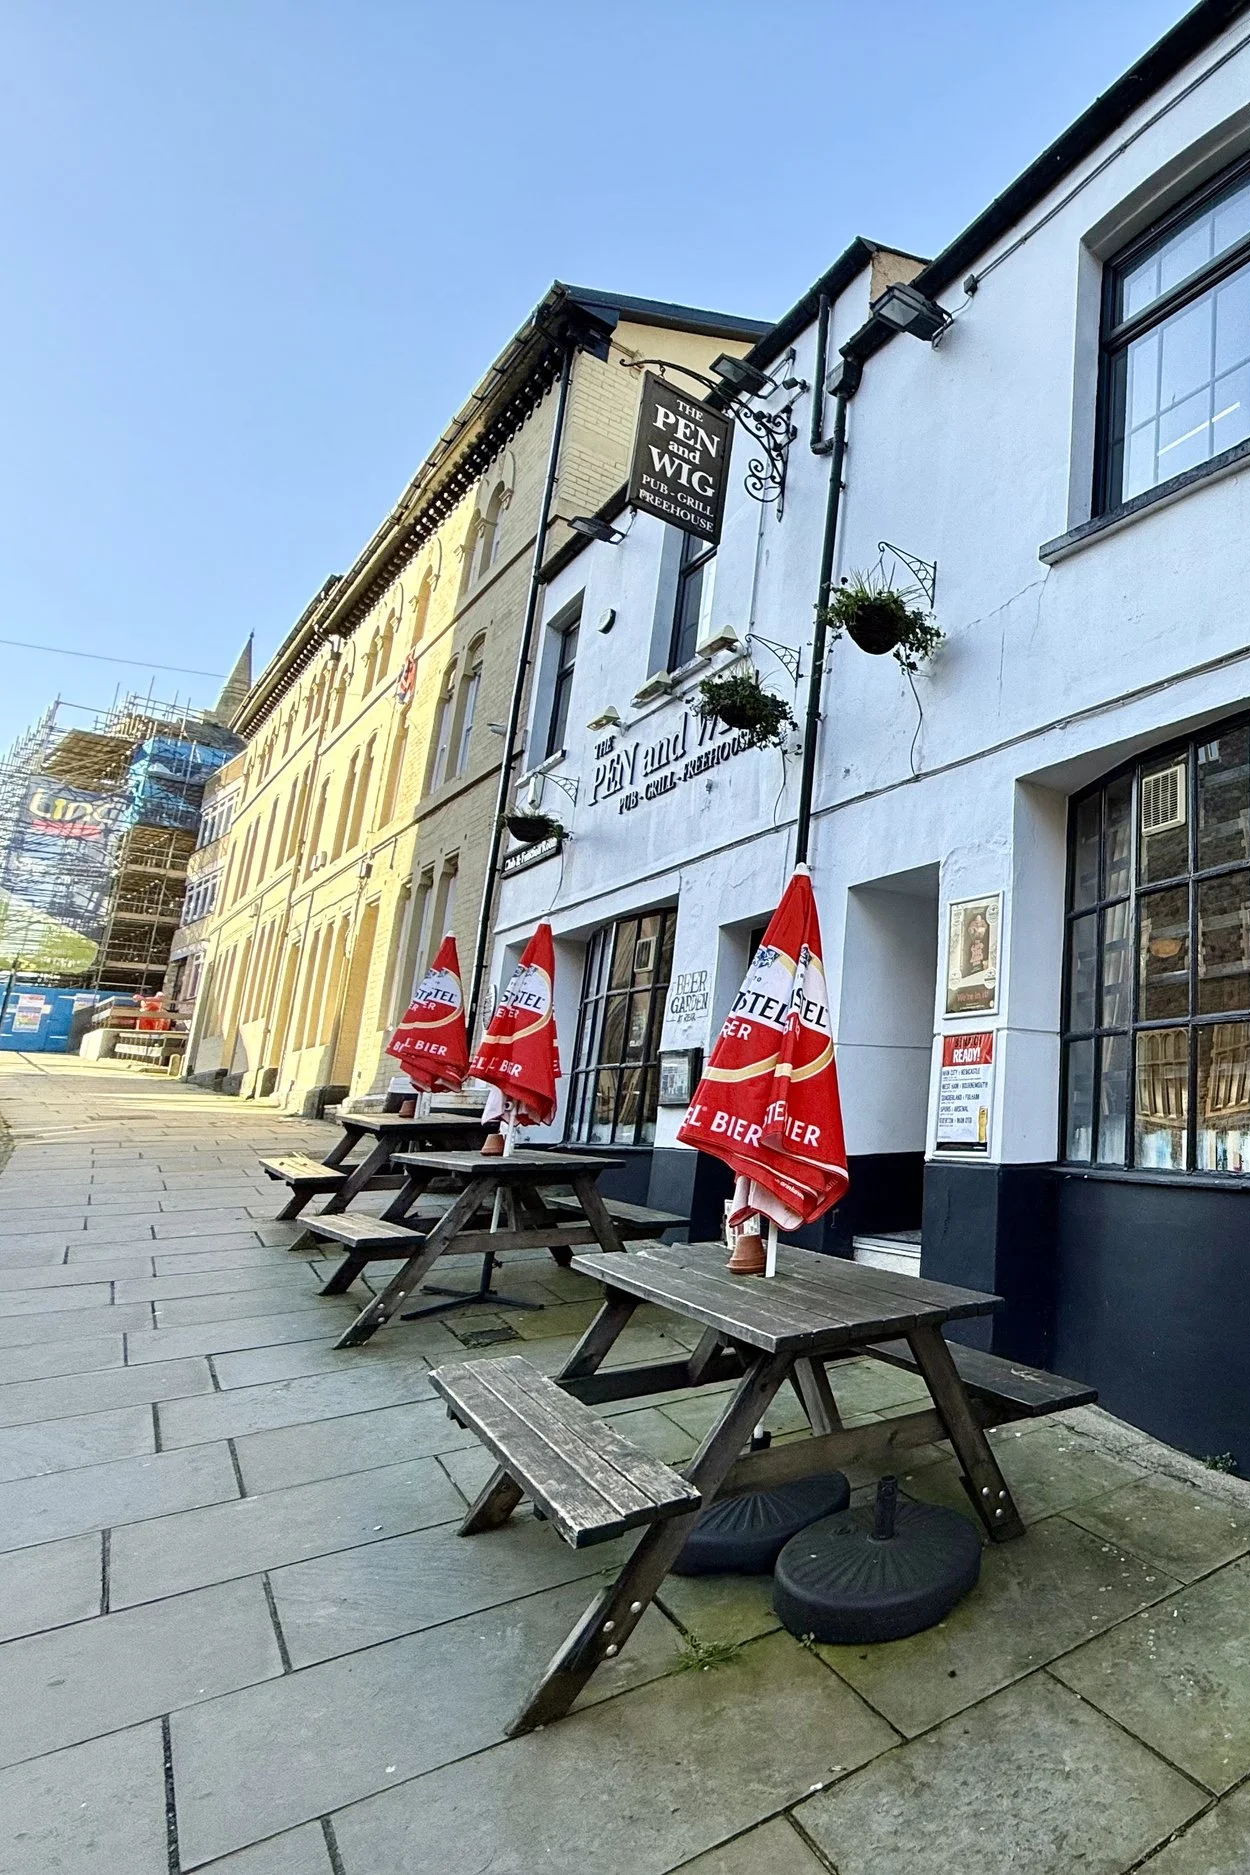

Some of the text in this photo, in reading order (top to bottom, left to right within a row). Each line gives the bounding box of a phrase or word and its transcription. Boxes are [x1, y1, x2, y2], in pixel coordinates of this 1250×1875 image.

[677, 399, 703, 422] THE
[652, 403, 720, 458] PEN
[668, 440, 700, 465] and
[648, 444, 715, 497] WIG
[642, 473, 668, 496] PUB
[677, 492, 714, 517] GRILL
[588, 742, 640, 806] PEN
[642, 711, 689, 777] and
[594, 735, 617, 760] THE
[676, 970, 708, 995] BEER
[670, 992, 709, 1014] GARDEN
[414, 1040, 448, 1056] BIER
[952, 1047, 981, 1063] READY!
[710, 1110, 763, 1148] BIER
